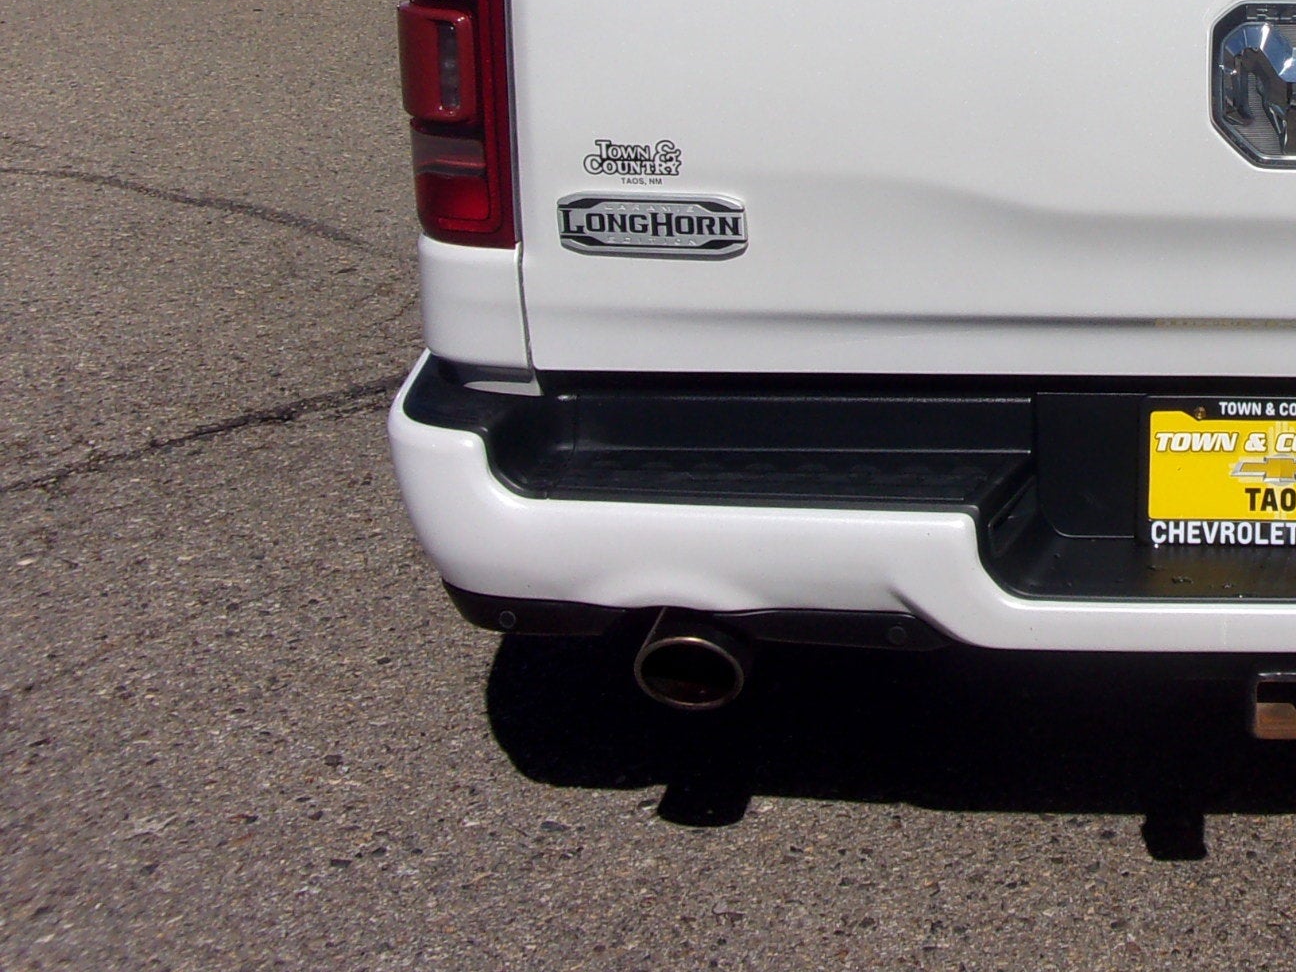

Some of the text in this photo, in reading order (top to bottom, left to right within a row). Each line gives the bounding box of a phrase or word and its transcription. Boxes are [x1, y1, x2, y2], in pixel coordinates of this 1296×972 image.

[595, 140, 681, 162] TOWN &
[583, 154, 682, 176] COUNTRY
[621, 177, 663, 186] TAOS, NM
[560, 209, 743, 237] LONGHORN
[1219, 401, 1262, 416] TOWN
[1265, 402, 1276, 416] &
[1155, 432, 1238, 453] TOWN
[1244, 432, 1267, 453] &
